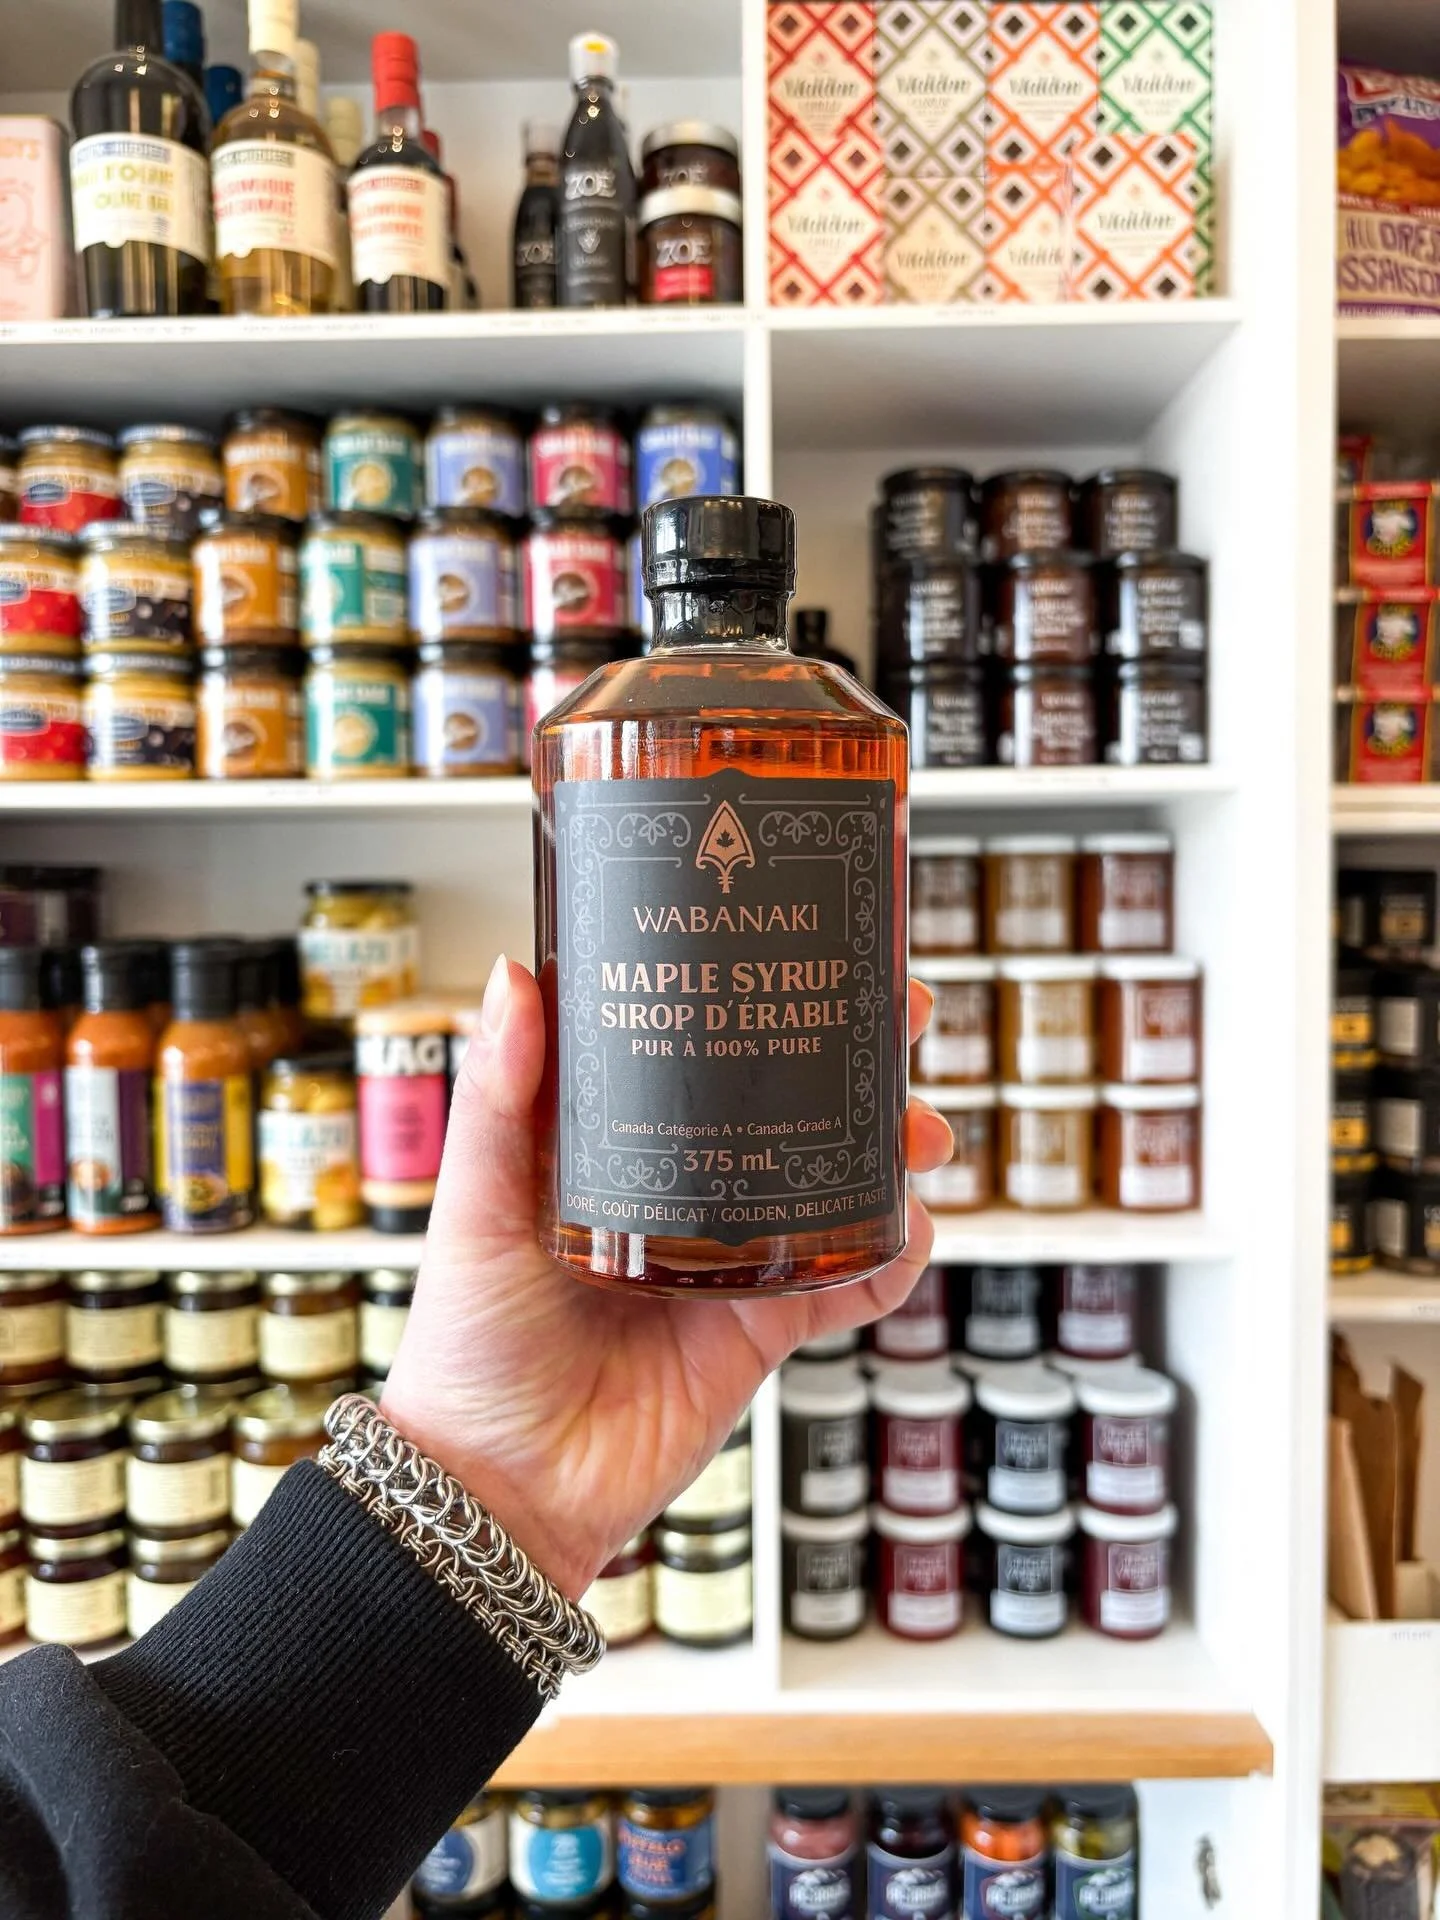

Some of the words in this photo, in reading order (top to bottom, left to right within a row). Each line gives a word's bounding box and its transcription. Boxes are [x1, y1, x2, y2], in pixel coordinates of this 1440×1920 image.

[565, 169, 617, 200] ZOE
[656, 235, 712, 268] ZOE
[633, 904, 819, 933] WABANAKI
[601, 961, 720, 993] MAPLE
[732, 959, 849, 992] SYRUP
[600, 1001, 695, 1030] SIROP
[705, 994, 849, 1031] D'ÉRABLE
[631, 1038, 674, 1056] PUR
[683, 1033, 697, 1056] À
[705, 1039, 759, 1056] 100%
[768, 1036, 822, 1055] PURE
[611, 1119, 654, 1135] Canada
[657, 1121, 720, 1139] Catégorie
[721, 1124, 732, 1137] A
[747, 1120, 796, 1136] Canada
[796, 1117, 832, 1134] Grade
[833, 1116, 842, 1129] A
[683, 1149, 734, 1172] 375
[741, 1147, 780, 1171] mL
[601, 1199, 640, 1219] GOÛT
[644, 1200, 707, 1223] DÉLICAT
[721, 1204, 792, 1222] GOLDEN,
[795, 1194, 855, 1218] DELICATE
[858, 1186, 888, 1209] TASTE
